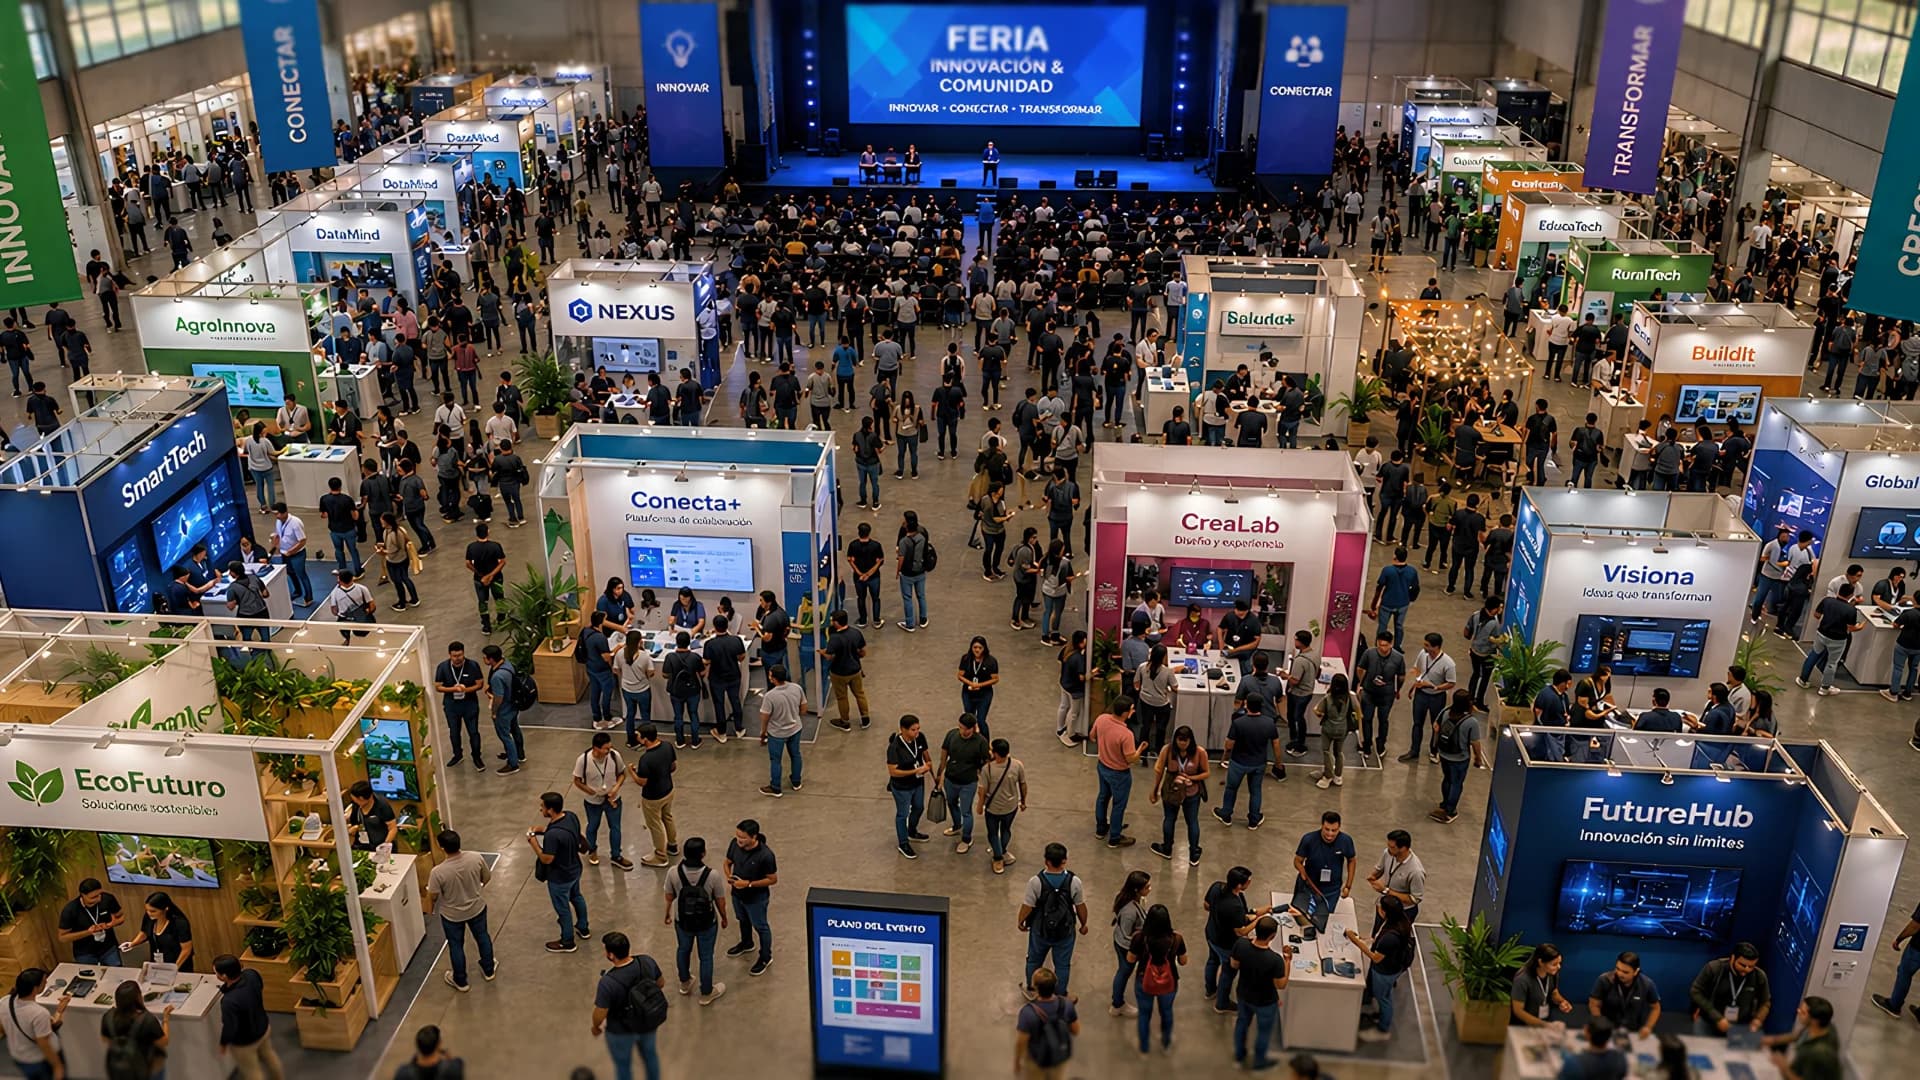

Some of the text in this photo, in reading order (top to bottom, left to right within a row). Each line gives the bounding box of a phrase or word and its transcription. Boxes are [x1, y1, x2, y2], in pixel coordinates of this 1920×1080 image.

[947, 25, 1049, 52] FERIA
[930, 57, 1064, 74] INNOVACIÓN &
[273, 25, 307, 144] CONECTAR
[656, 82, 710, 93] INNOVAR
[939, 78, 1053, 93] COMUNIDAD
[1269, 86, 1333, 97] CONECTAR
[889, 103, 939, 113] INNOVAR
[1612, 24, 1654, 176] TRANSFORMAR
[1539, 219, 1602, 232] EducaTech
[316, 228, 380, 241] DataMind
[1611, 268, 1681, 281] RuralTech
[598, 303, 675, 321] NEXUS
[175, 316, 276, 335] AgroInnova
[1692, 345, 1756, 362] BuildIt
[122, 430, 207, 508] SmartTech
[1865, 474, 1919, 489] Global
[631, 491, 741, 512] Conecta+
[1181, 513, 1280, 534] CreaLab
[1213, 539, 1220, 548] y
[1603, 564, 1694, 585] Visiona
[1642, 590, 1712, 602] transforman
[74, 768, 226, 798] EcoFuturo
[82, 799, 218, 816] Soluciones sostenibles
[1582, 796, 1754, 828] FutureHub
[1579, 829, 1664, 846] Innovación
[1667, 833, 1689, 847] sin
